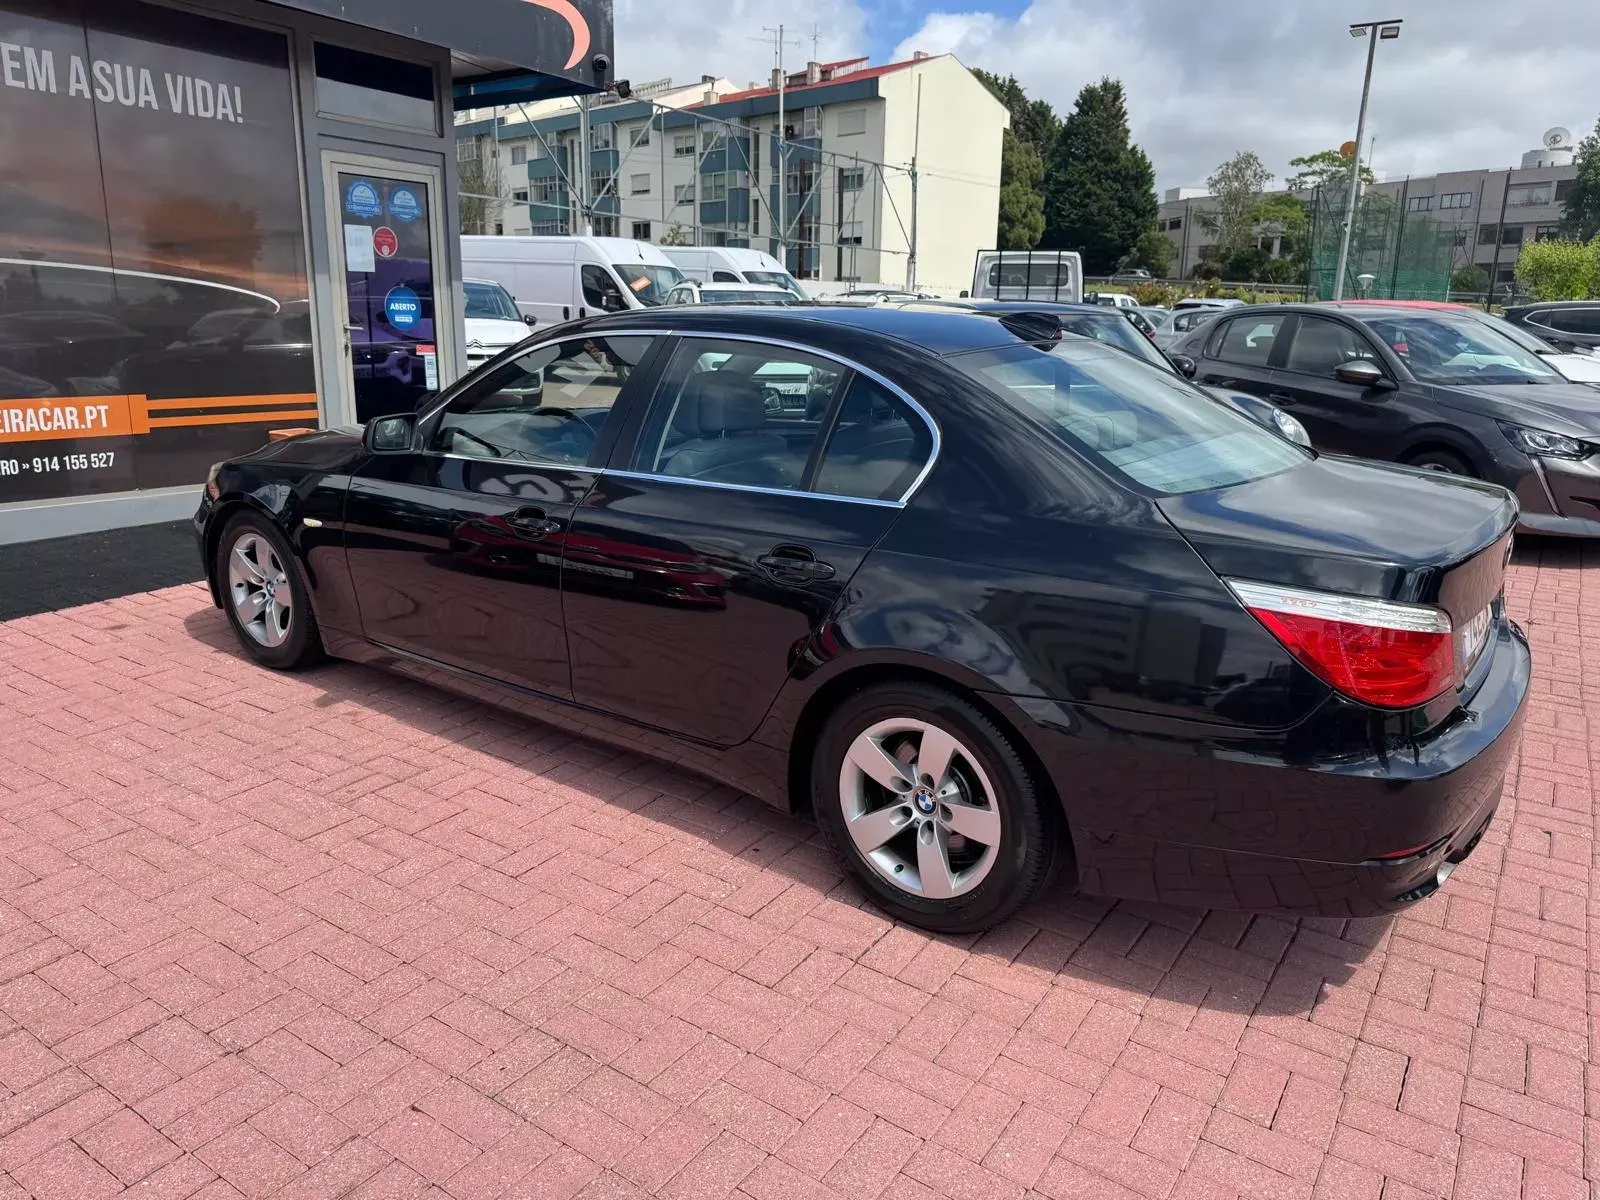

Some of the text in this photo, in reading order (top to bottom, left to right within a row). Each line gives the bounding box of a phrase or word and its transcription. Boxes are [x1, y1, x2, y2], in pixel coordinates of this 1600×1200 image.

[165, 72, 244, 124] VIDA!
[390, 302, 417, 311] ABERTO
[33, 456, 60, 473] 914
[63, 454, 88, 470] 155
[91, 452, 115, 468] 527
